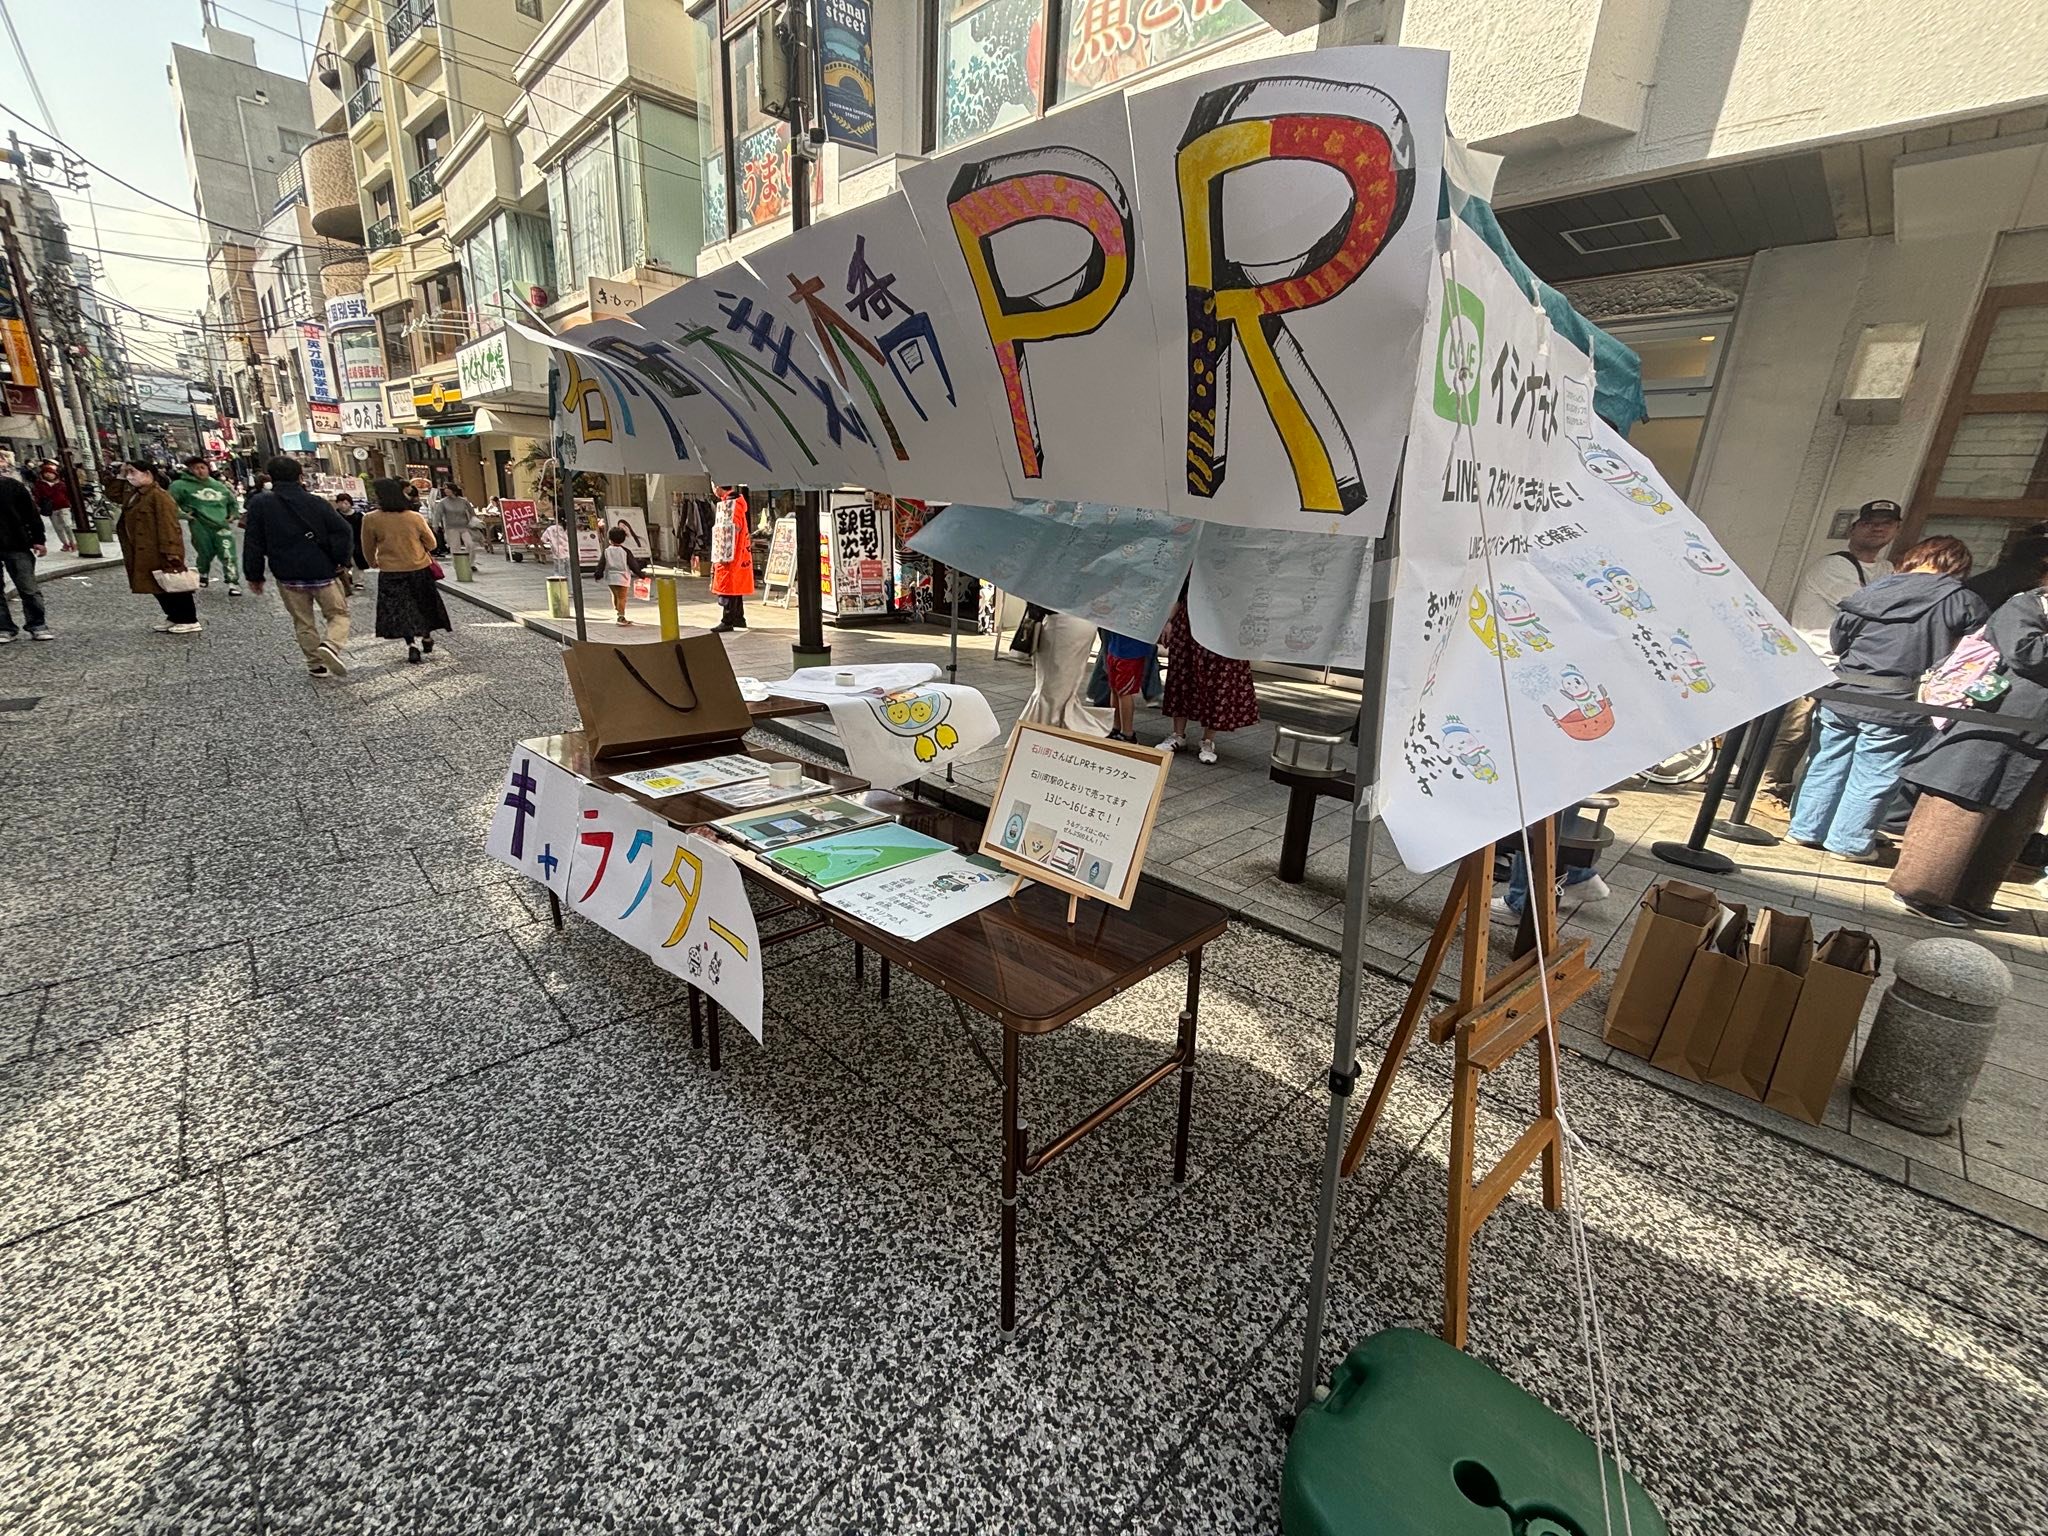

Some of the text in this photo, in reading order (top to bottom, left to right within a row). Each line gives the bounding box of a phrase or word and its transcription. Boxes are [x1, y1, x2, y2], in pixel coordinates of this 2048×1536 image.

[825, 5, 865, 36] street
[832, 0, 867, 24] canal
[596, 287, 637, 307] きもの
[504, 505, 535, 522] SALE
[1031, 743, 1138, 781] 石川町さんばしPRキャラクター
[1030, 769, 1128, 808] 石川町駅のとおりで売ってます
[502, 758, 750, 961] キャラクター
